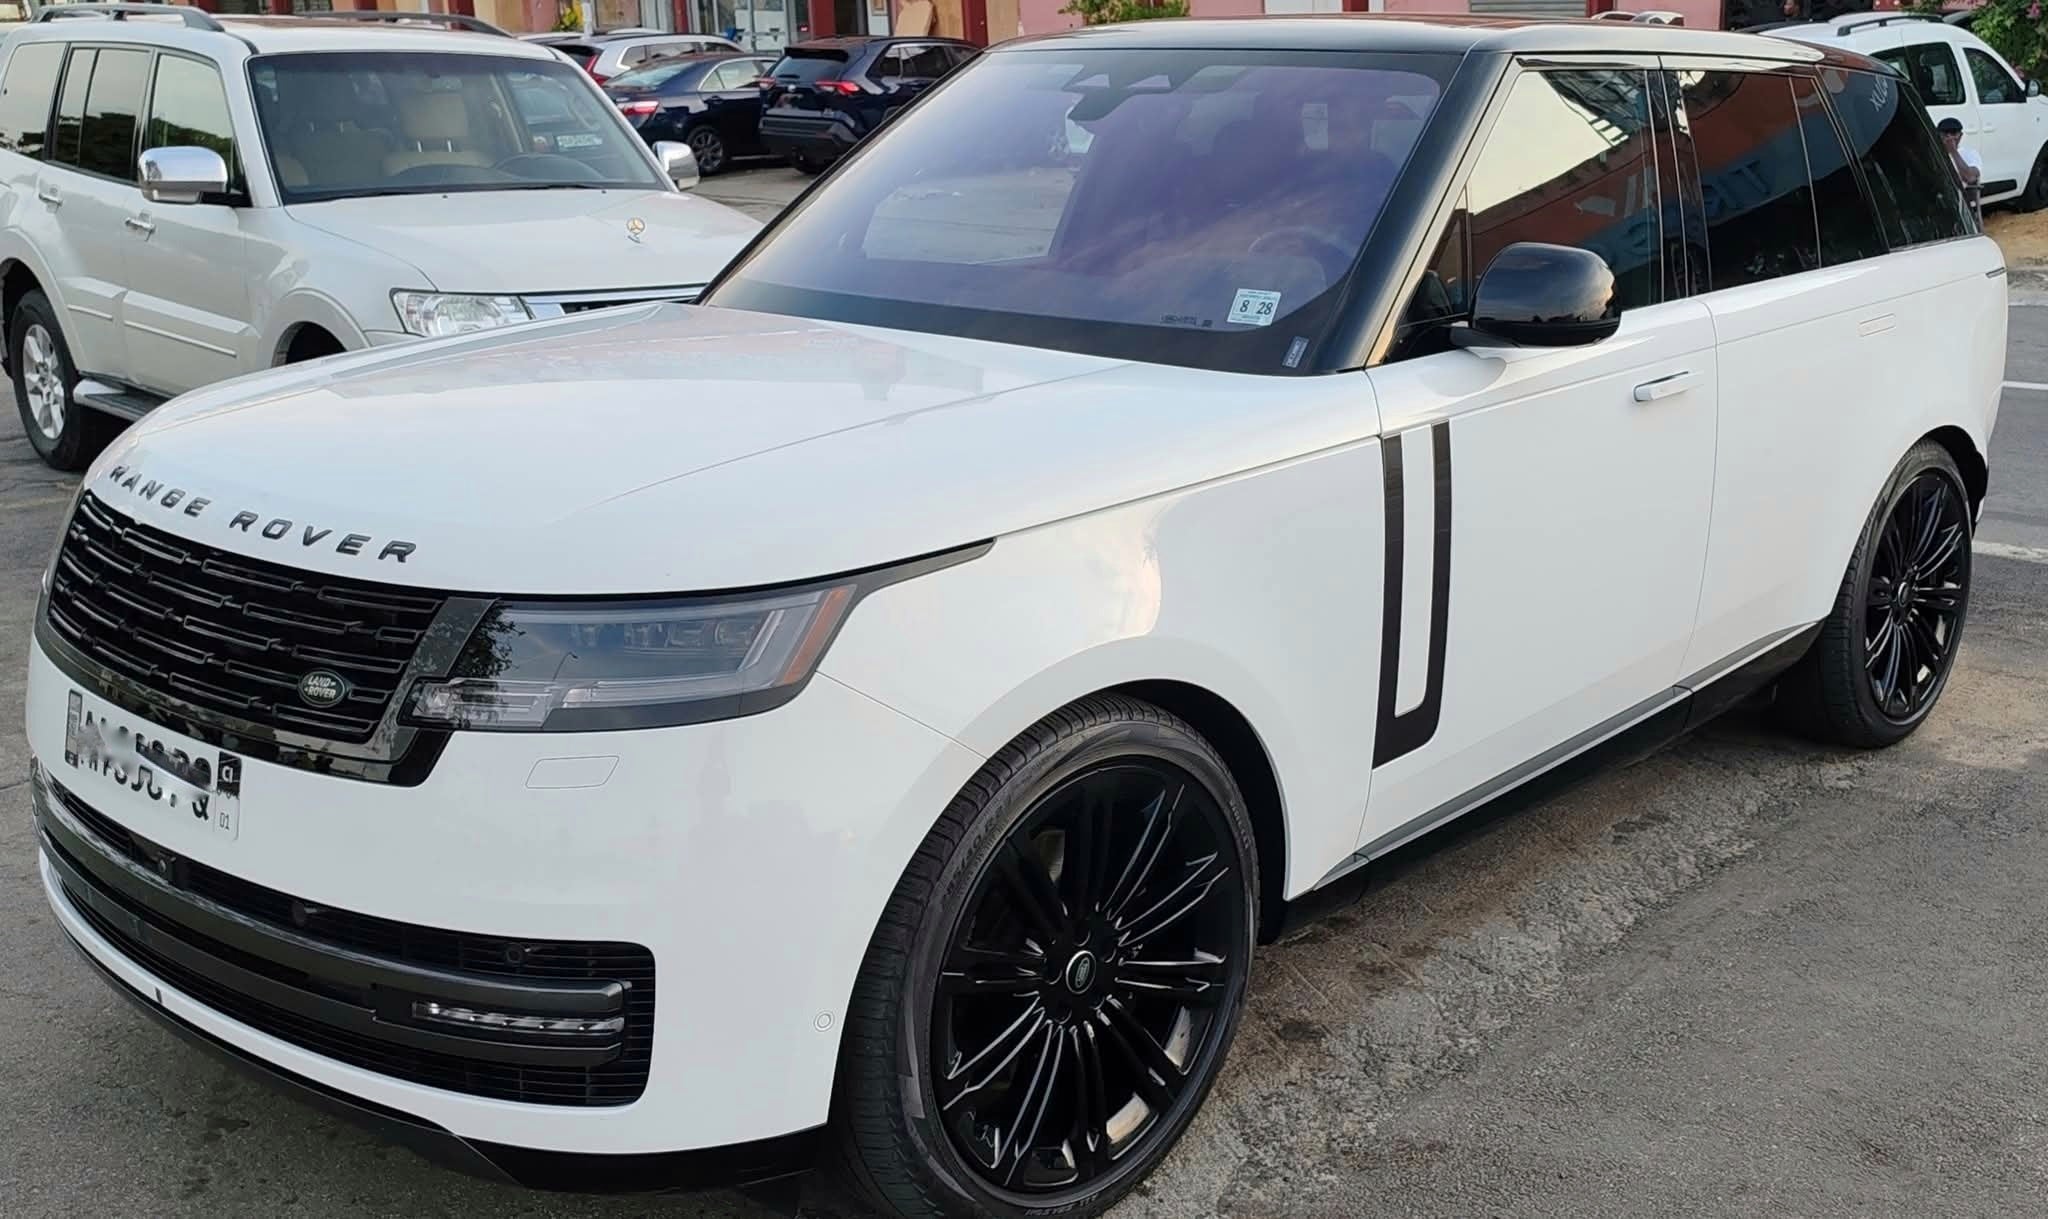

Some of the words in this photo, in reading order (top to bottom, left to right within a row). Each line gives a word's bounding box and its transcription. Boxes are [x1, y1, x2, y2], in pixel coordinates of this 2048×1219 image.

[1240, 300, 1250, 313] 8
[1256, 301, 1274, 315] 28
[109, 465, 211, 518] RANGE
[229, 510, 417, 563] ROVER
[307, 675, 332, 687] LAND
[307, 686, 336, 699] ROVER
[220, 812, 229, 830] 01
